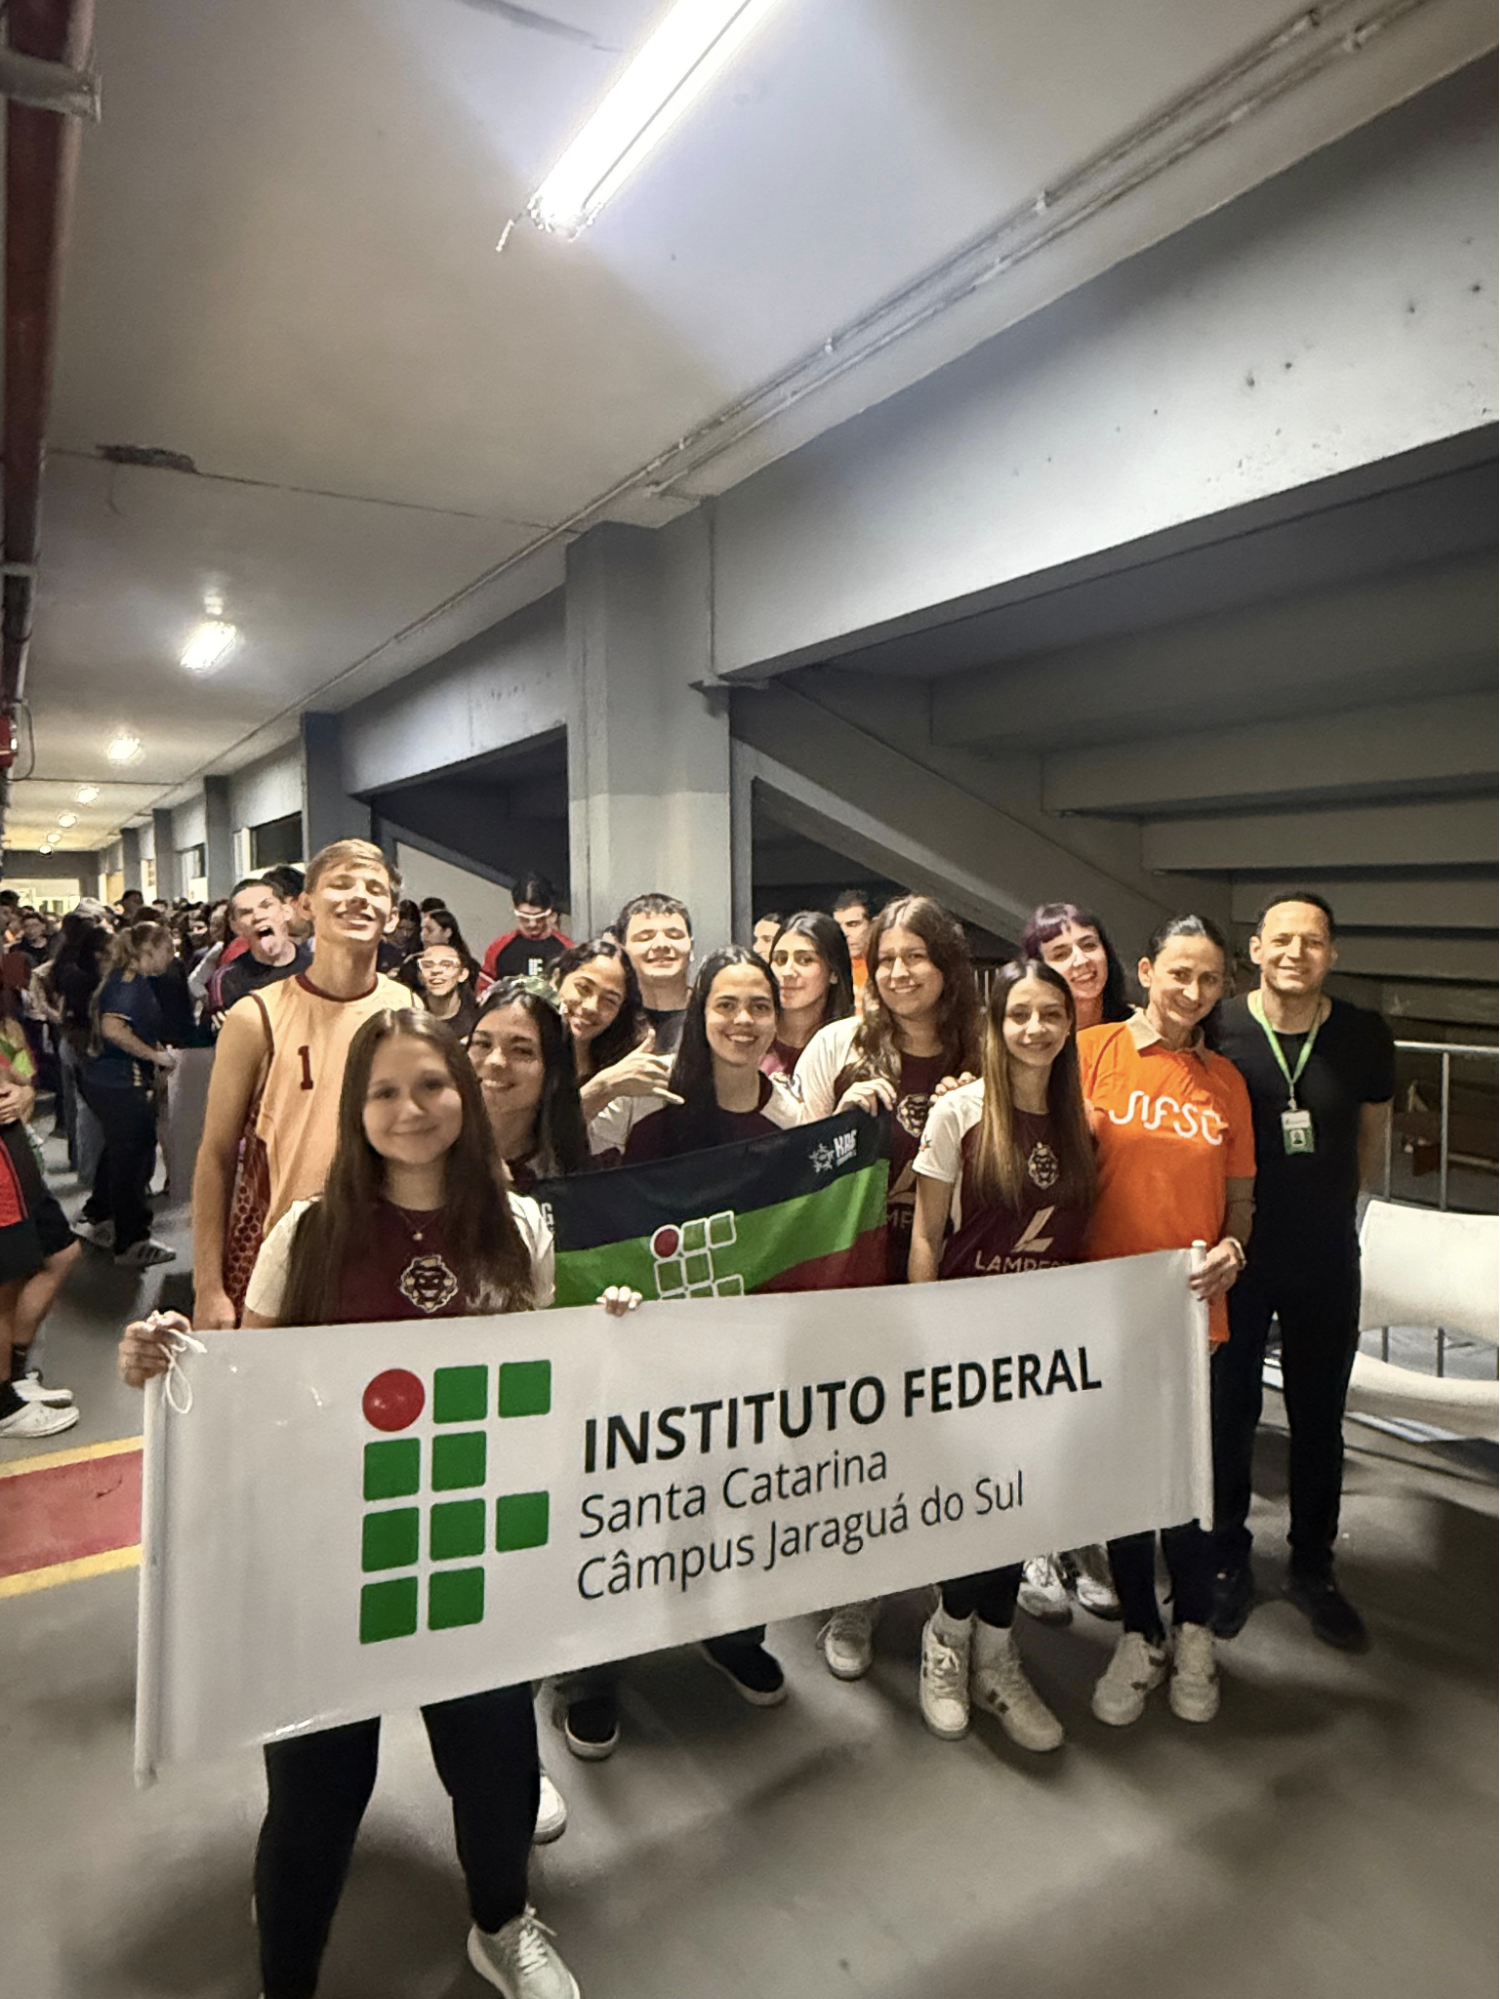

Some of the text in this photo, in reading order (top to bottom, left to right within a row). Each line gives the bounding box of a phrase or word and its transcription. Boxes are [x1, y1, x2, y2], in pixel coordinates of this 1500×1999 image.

[297, 1045, 314, 1090] 1
[584, 1345, 1103, 1475] INSTITUTO FEDERAL
[577, 1469, 1023, 1601] Câmpus Jaraguá do Sul
[579, 1449, 888, 1540] Santa Catarina
